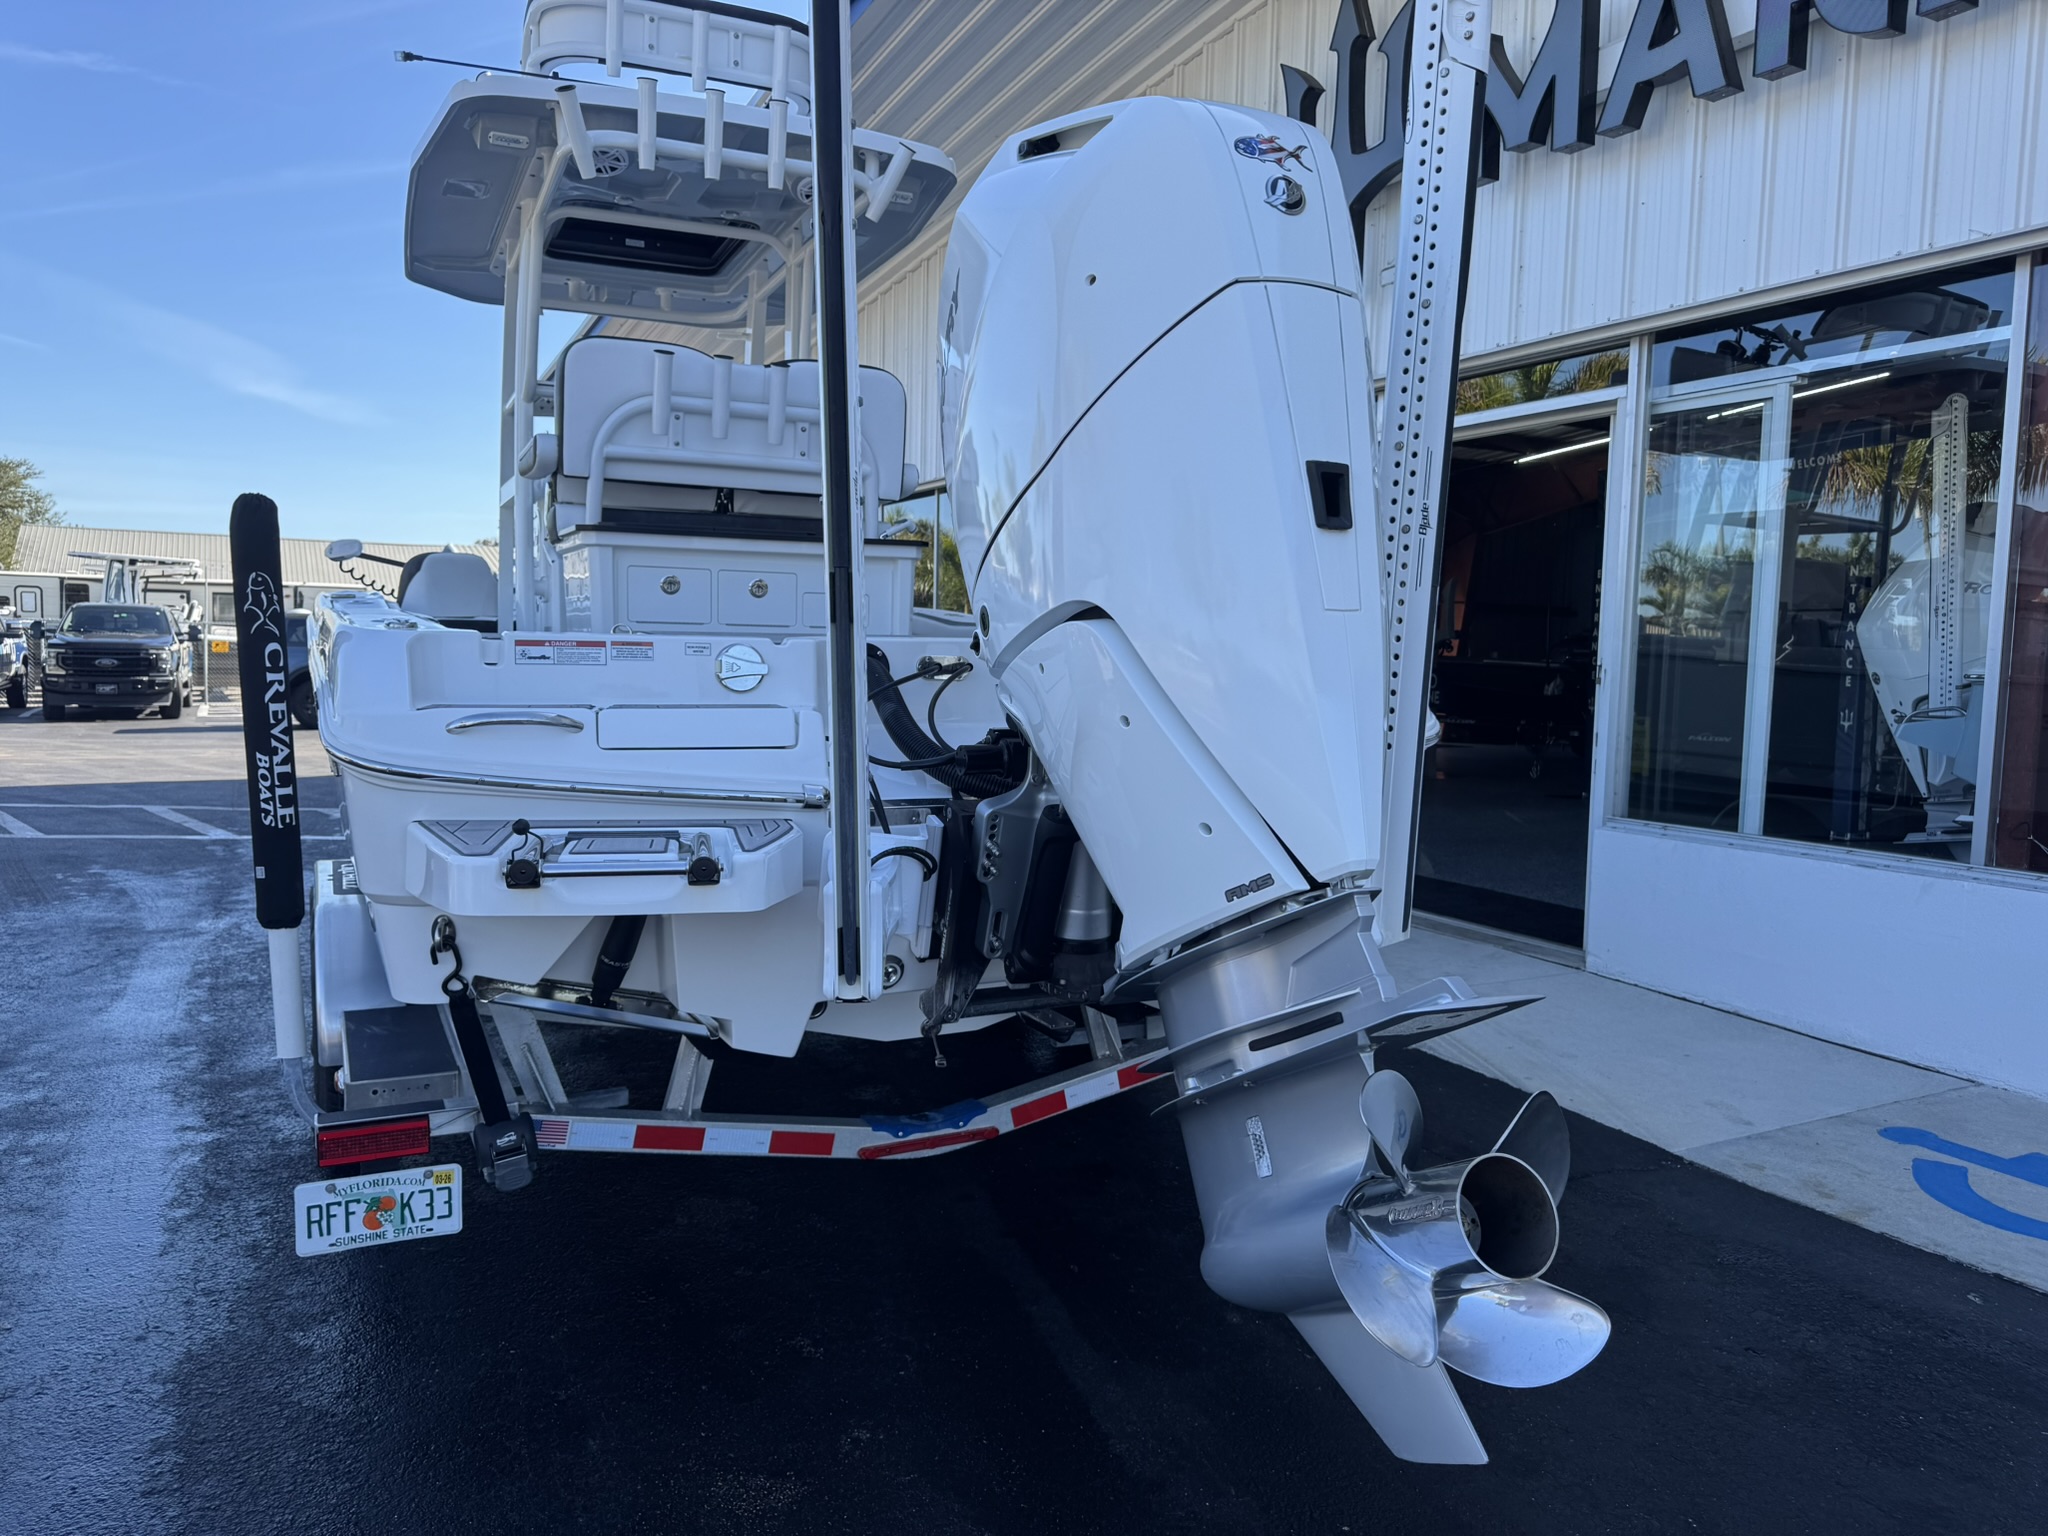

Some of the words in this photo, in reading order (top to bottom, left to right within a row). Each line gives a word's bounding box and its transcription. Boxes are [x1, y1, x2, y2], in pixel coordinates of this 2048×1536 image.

[1418, 502, 1433, 536] Blade
[1844, 548, 1859, 687] ENTRANCE
[264, 642, 296, 829] CREVALLE
[255, 751, 275, 828] BOATS
[1225, 873, 1275, 903] AMS
[333, 1177, 426, 1199] MYFLORIDA.COM
[434, 1173, 452, 1184] 03-26
[306, 1198, 361, 1239] RFF
[400, 1186, 453, 1225] K33
[335, 1230, 388, 1248] SUNSHINE
[393, 1224, 426, 1238] STATE
